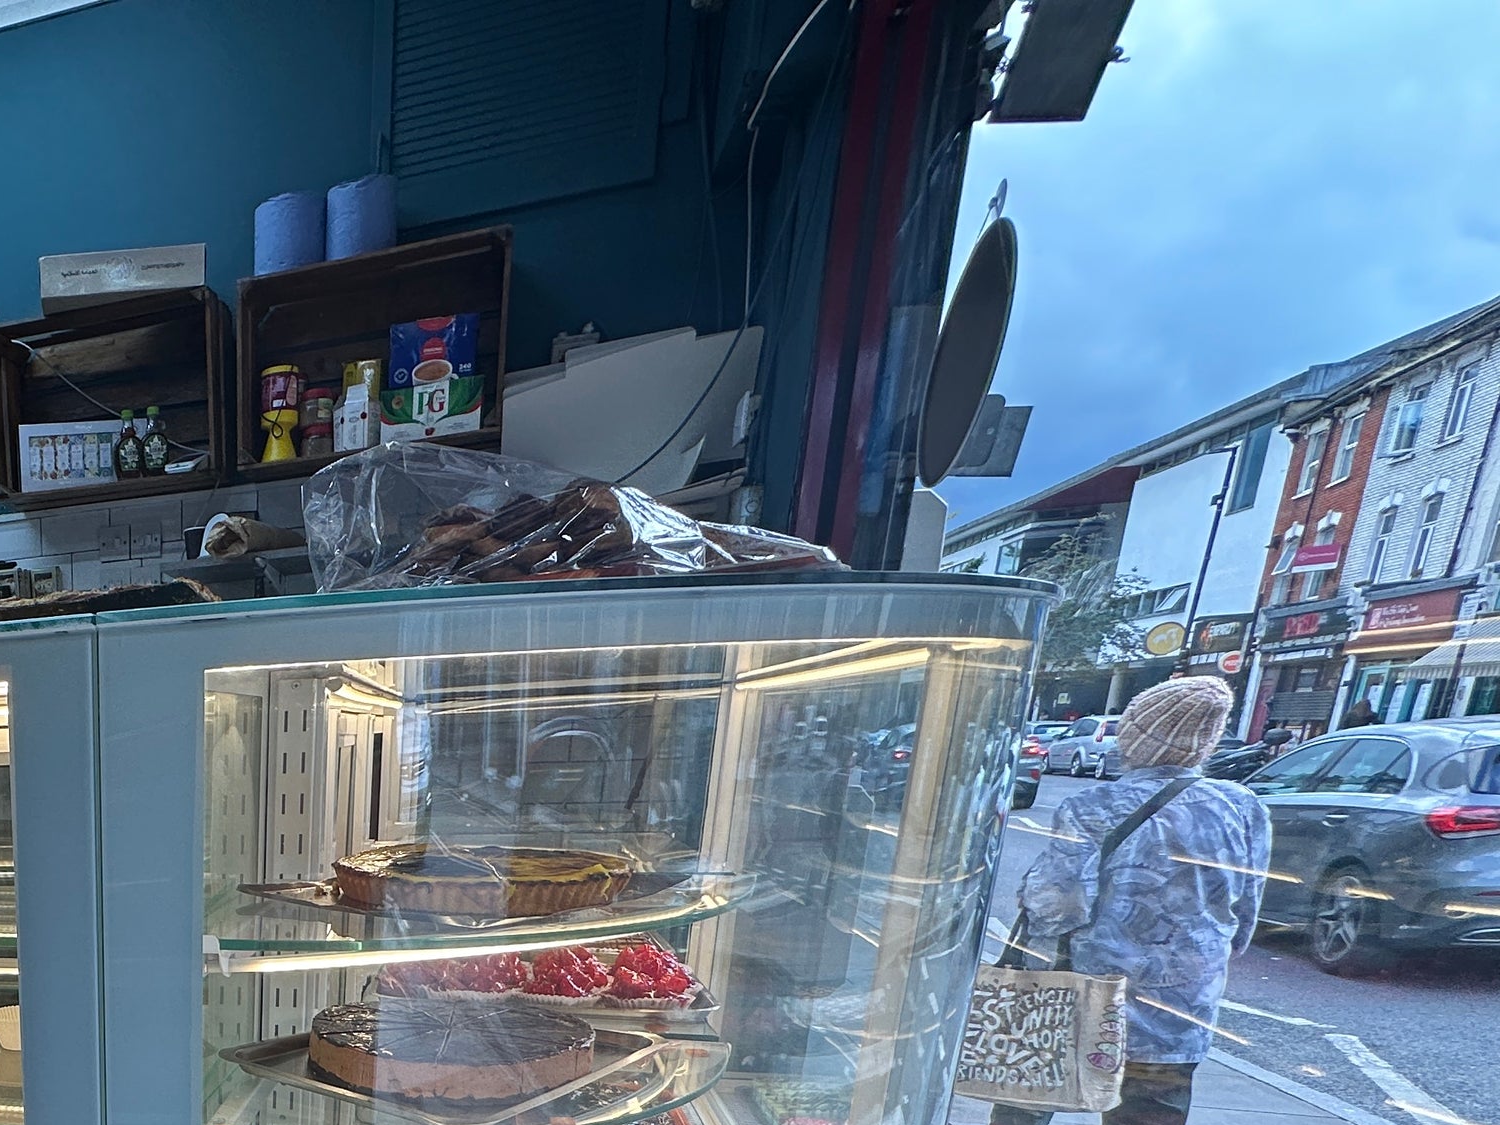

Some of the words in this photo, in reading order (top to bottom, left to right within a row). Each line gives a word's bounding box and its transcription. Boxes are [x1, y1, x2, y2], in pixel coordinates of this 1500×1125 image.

[417, 389, 445, 415] PG
[1010, 1005, 1073, 1039] UNITY
[974, 1031, 1044, 1075] LOVE
